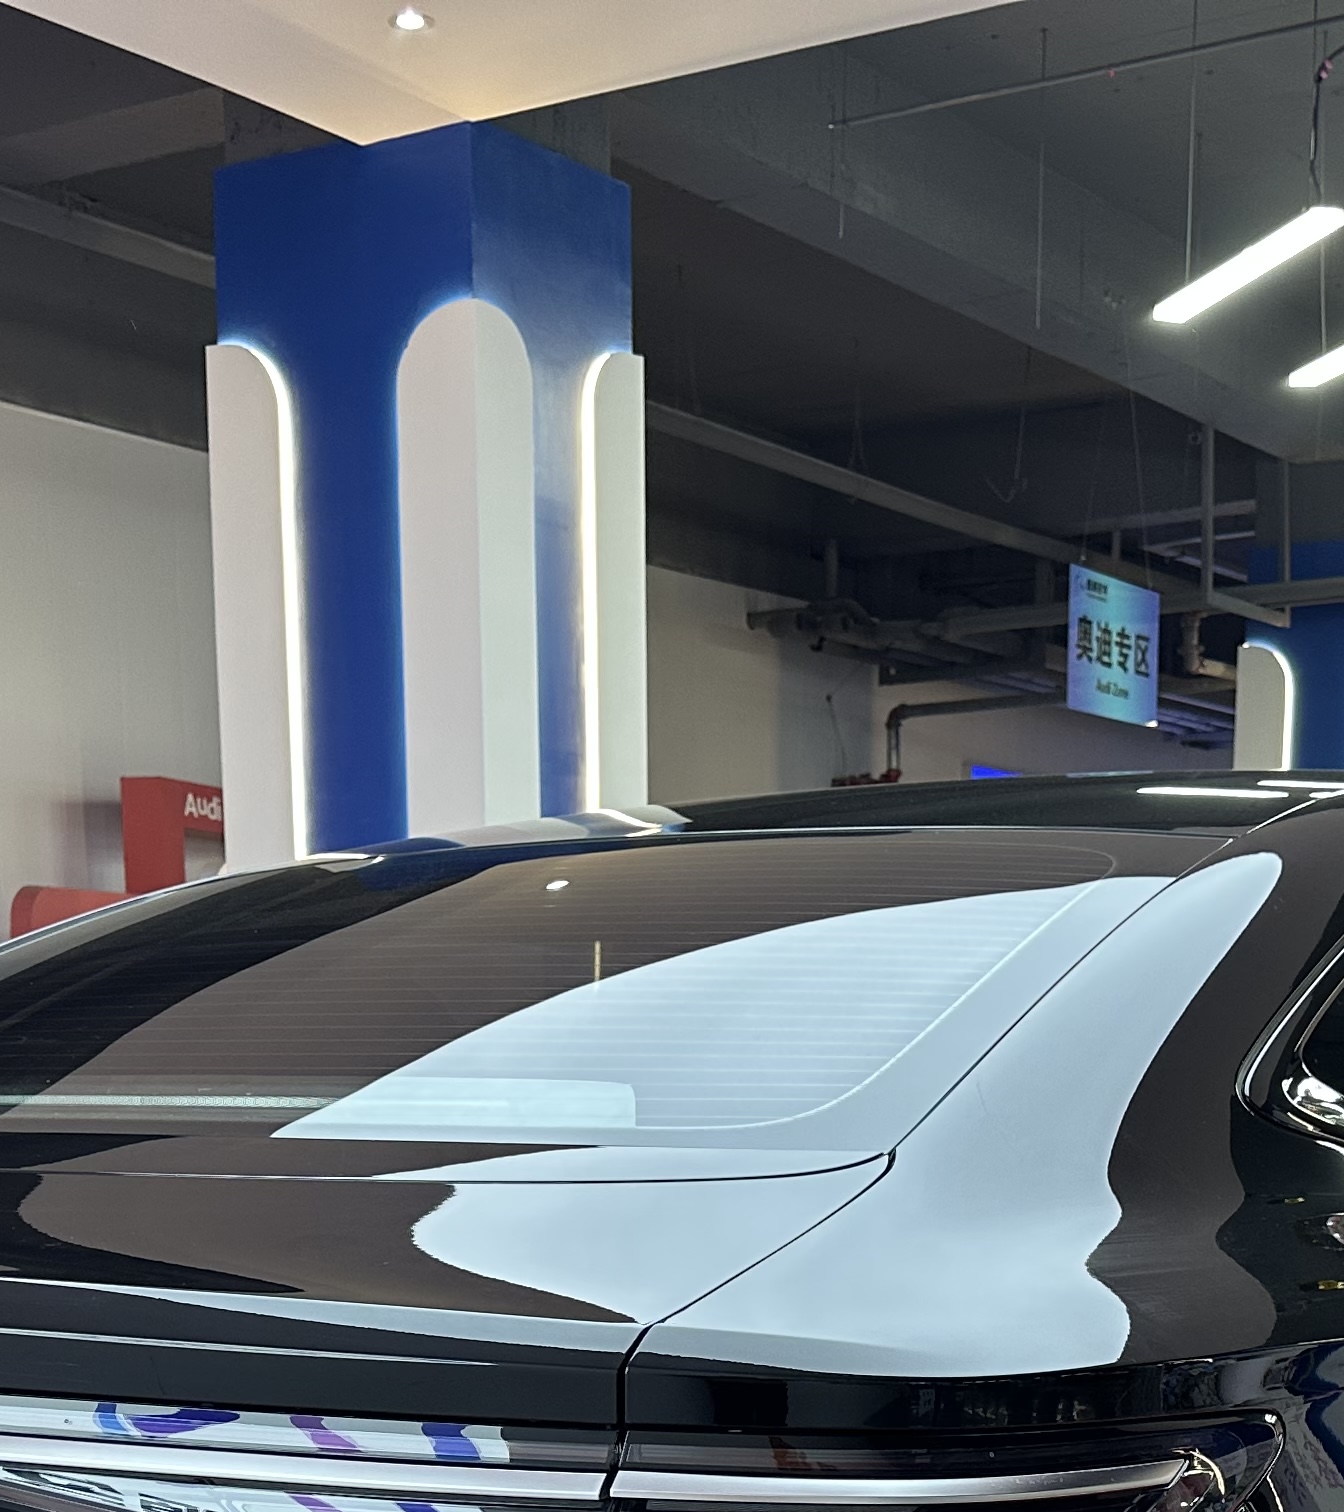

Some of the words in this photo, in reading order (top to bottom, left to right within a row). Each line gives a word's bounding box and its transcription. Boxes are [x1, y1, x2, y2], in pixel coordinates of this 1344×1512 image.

[1076, 614, 1150, 679] 奥迪专区
[184, 792, 223, 822] Audi
